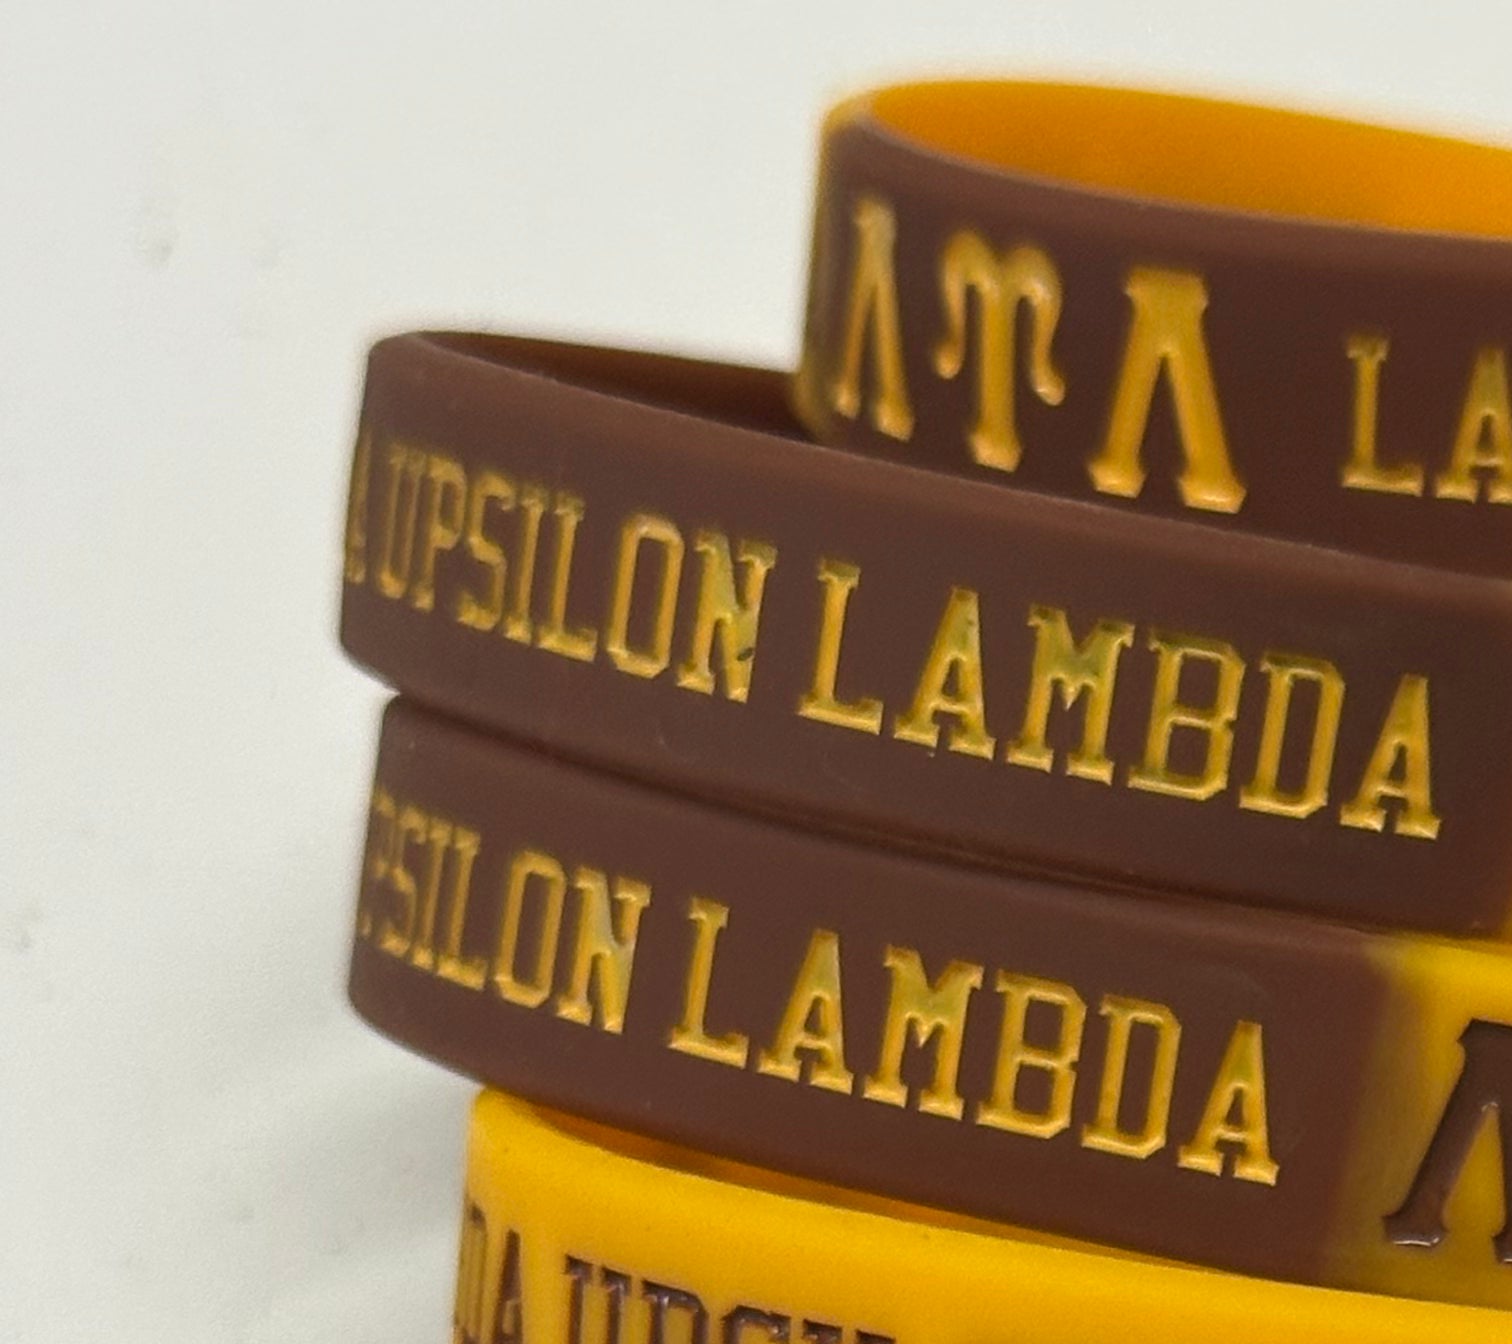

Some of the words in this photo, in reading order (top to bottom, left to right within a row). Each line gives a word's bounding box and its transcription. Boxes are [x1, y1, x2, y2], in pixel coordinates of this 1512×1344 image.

[375, 440, 777, 704] UPSILON
[797, 558, 1443, 840] LAMBDA
[667, 895, 1280, 1187] LAMBDA
